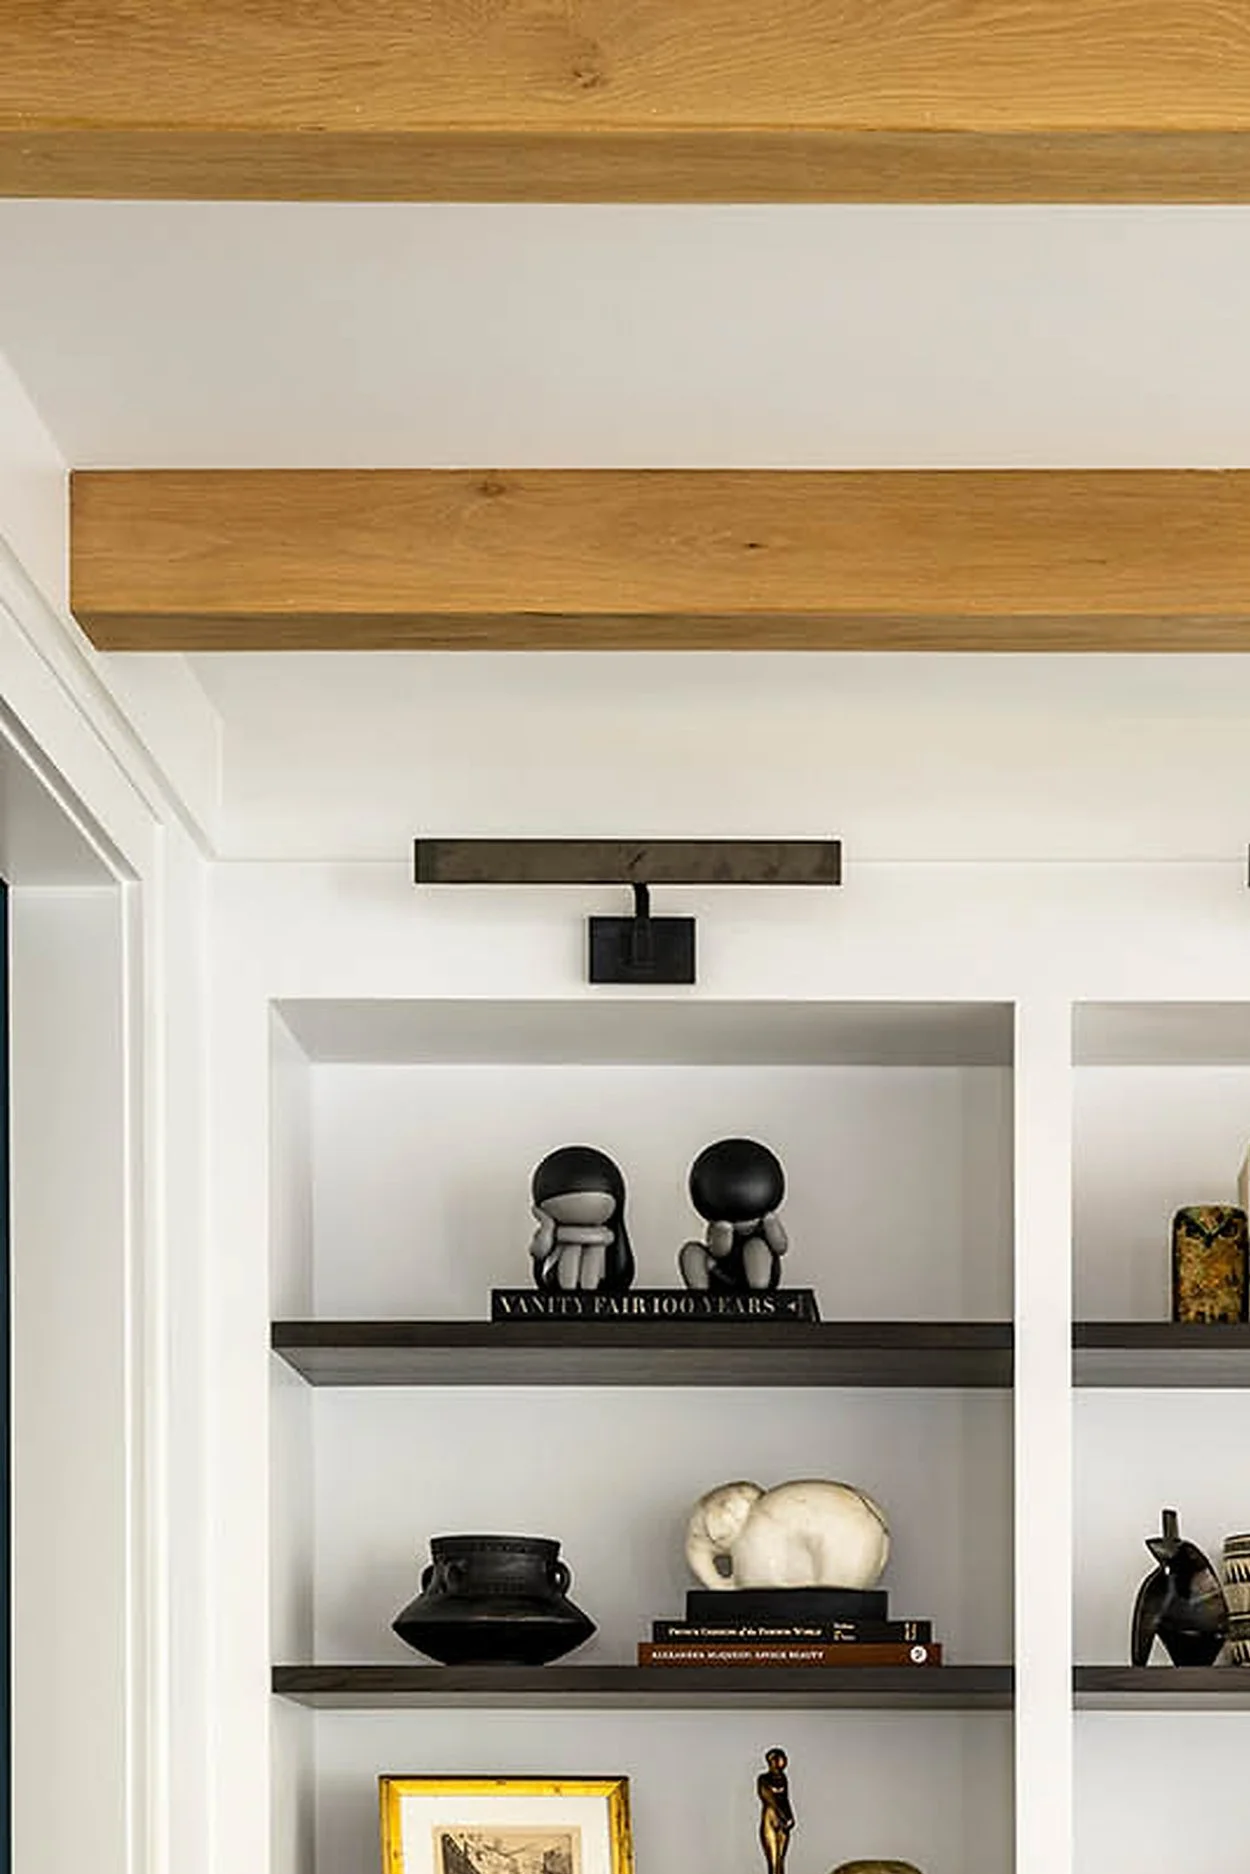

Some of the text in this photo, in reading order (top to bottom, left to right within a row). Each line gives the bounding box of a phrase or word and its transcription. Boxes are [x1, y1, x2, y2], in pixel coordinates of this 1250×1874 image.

[500, 1295, 776, 1314] VANITY FAIR 100 YEARS
